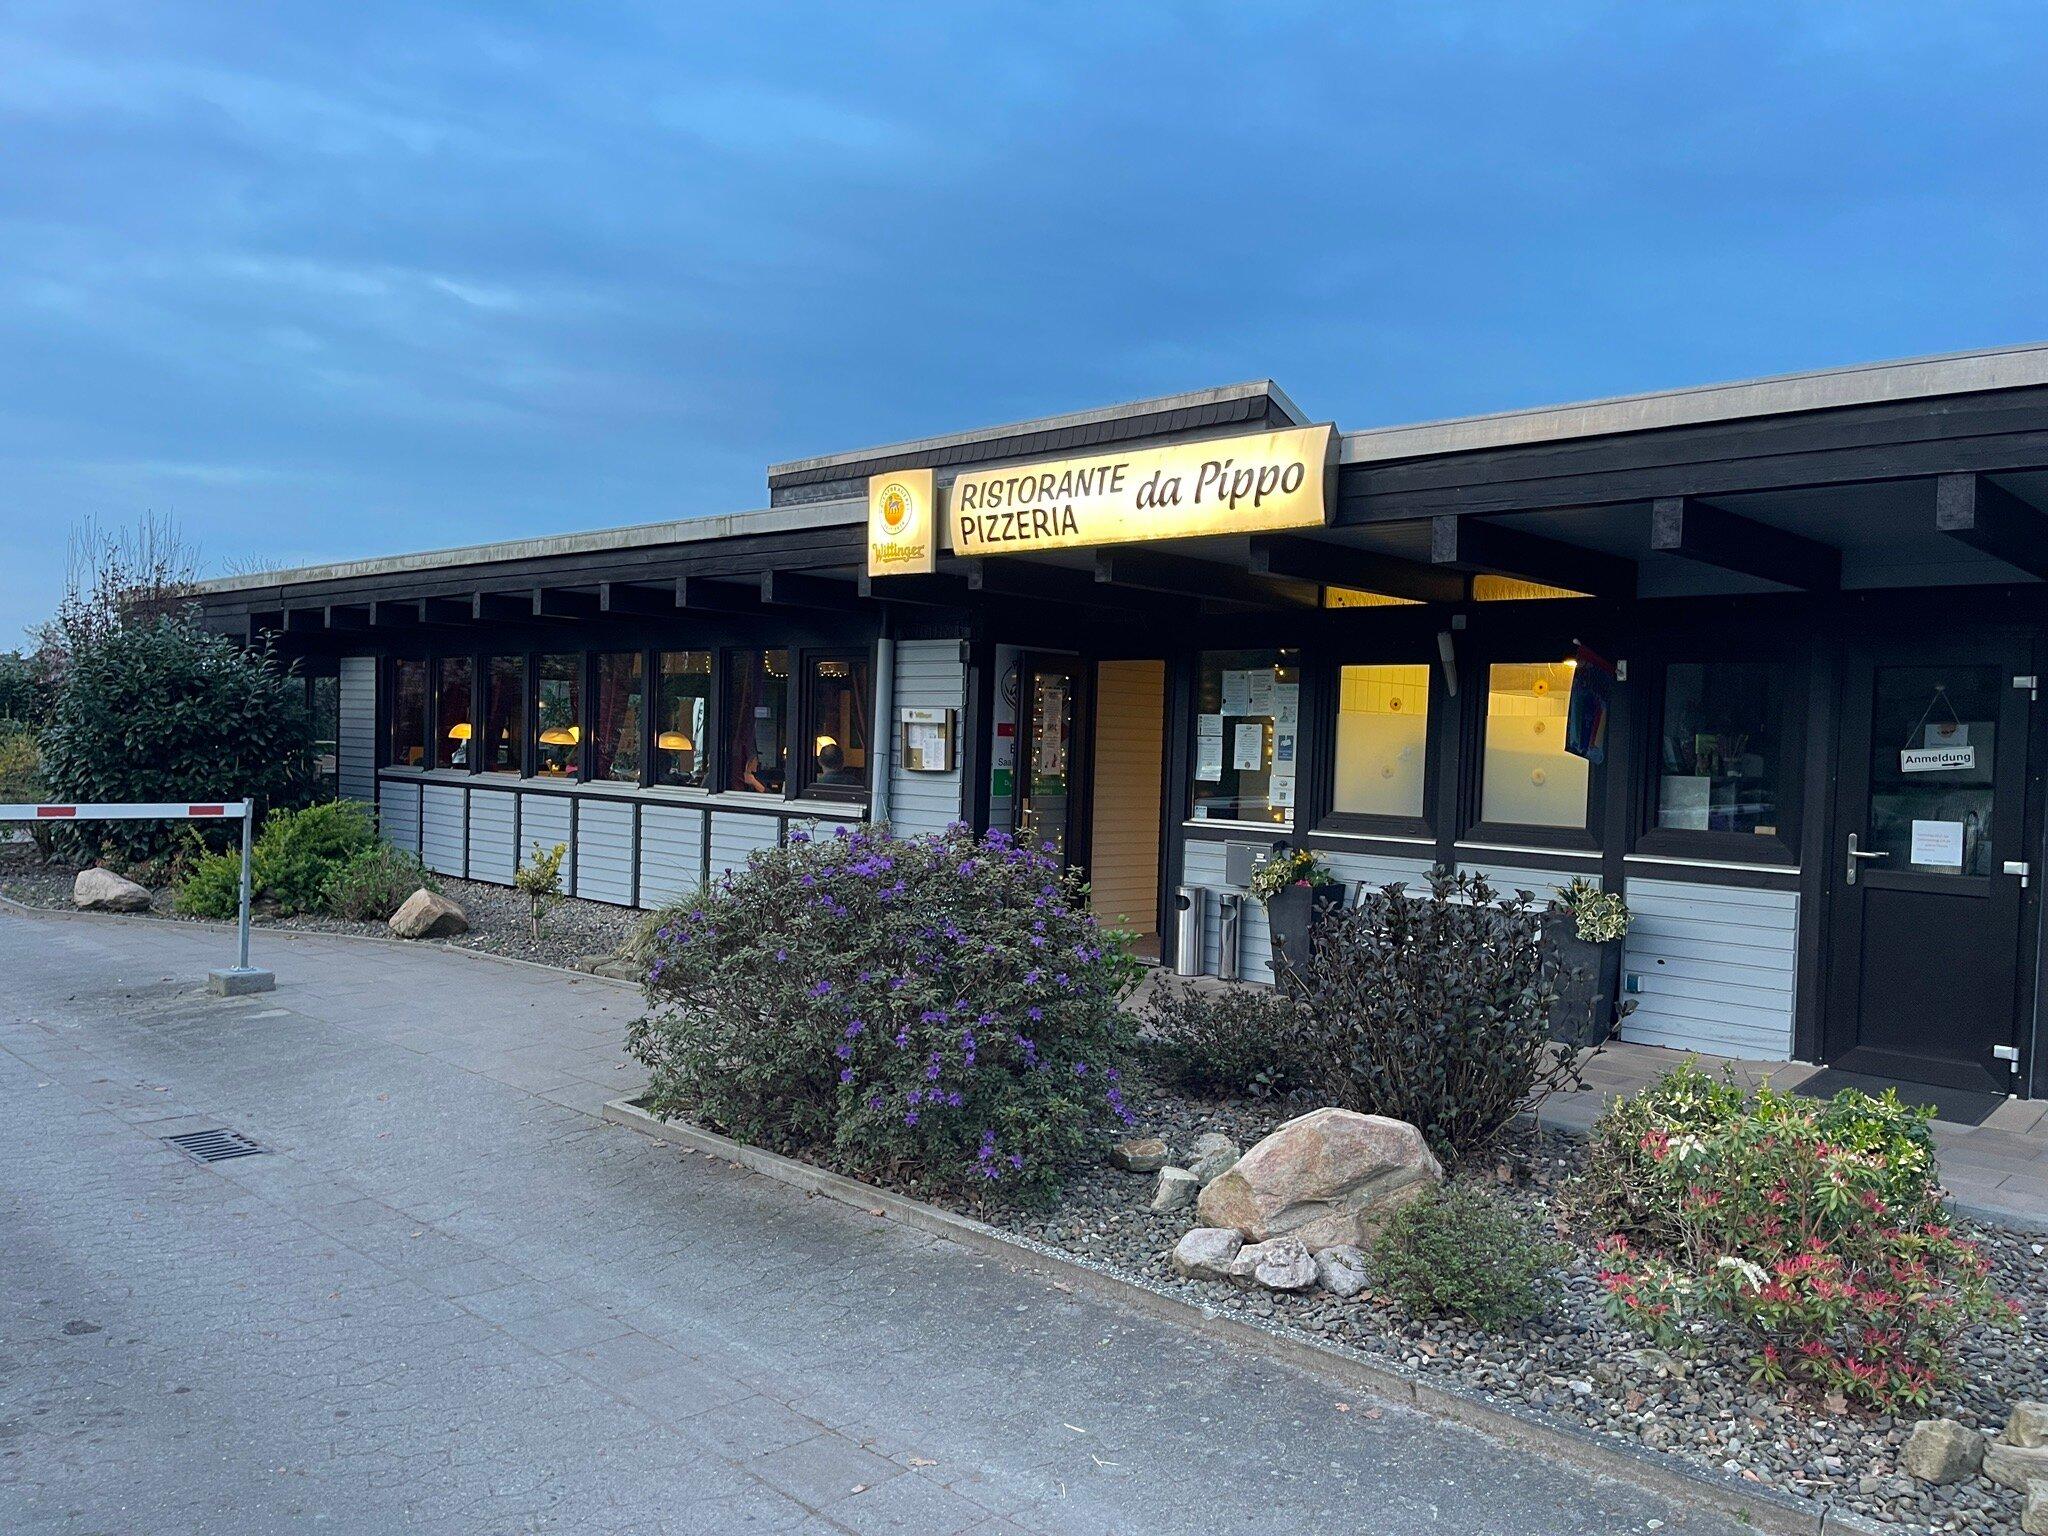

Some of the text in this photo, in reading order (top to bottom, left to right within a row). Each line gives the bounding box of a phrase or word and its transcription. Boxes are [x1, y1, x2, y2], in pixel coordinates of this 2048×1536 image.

[960, 463, 1130, 511] RISTORANTE
[1136, 459, 1306, 511] da Pippo
[960, 504, 1079, 545] PIZZERIA
[872, 542, 925, 563] Wittinger
[1905, 753, 1971, 763] Anmeldung
